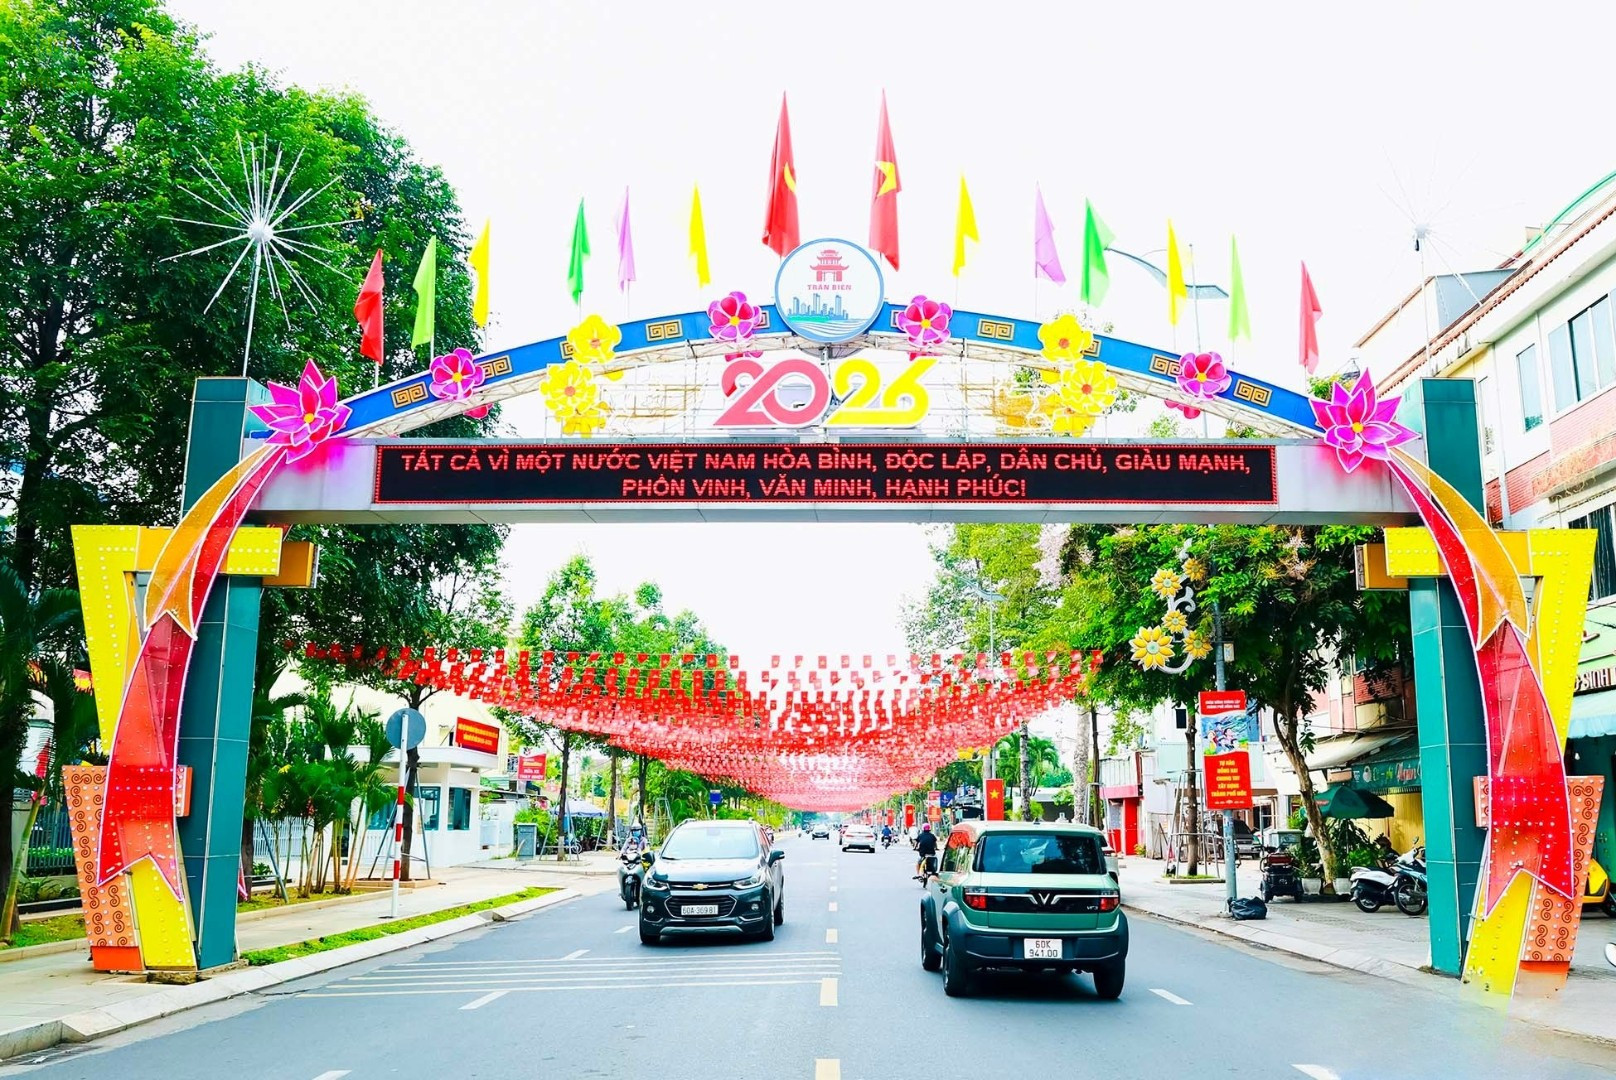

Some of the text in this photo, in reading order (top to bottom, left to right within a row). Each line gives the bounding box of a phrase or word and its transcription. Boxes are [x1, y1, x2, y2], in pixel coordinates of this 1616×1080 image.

[713, 358, 938, 426] 2026
[401, 447, 1250, 475] TẤT CẢ VÌ MỘT NƯỚC VIỆT NAM HÒA BÌNH, ĐỘC LẬP, DÂN CHỦ, GIÀU MẠNH,
[692, 478, 750, 500] VINH,
[759, 473, 806, 497] VĂN
[814, 478, 877, 500] MINH,
[886, 478, 949, 500] HẠNH
[957, 473, 1026, 497] PHÚC!
[1035, 940, 1051, 949] 60K
